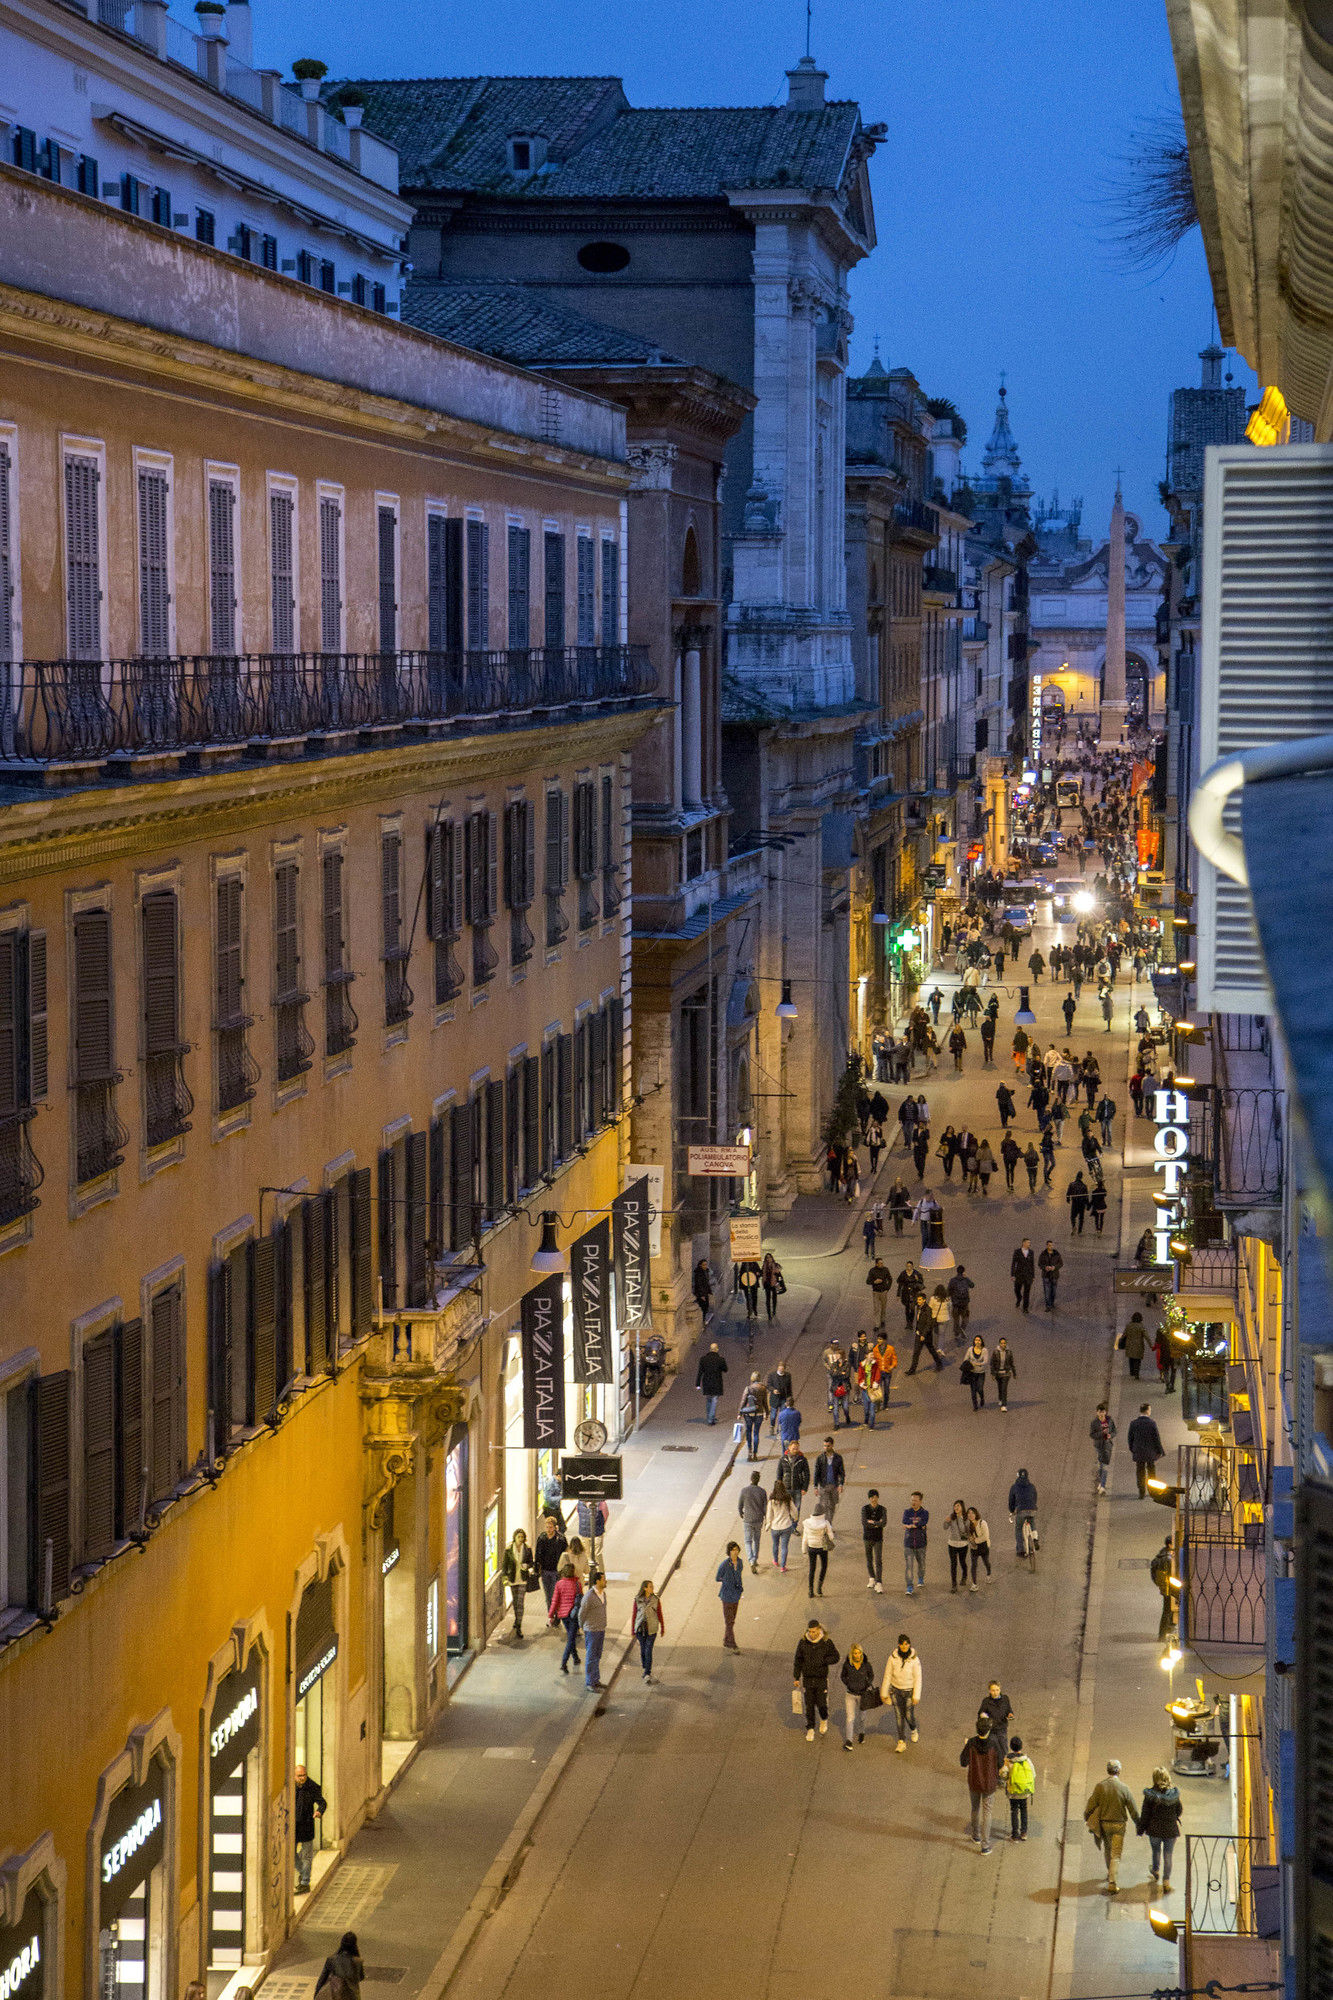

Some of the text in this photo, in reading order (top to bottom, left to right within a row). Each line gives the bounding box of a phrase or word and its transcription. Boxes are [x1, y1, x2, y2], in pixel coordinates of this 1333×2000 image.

[1153, 1090, 1190, 1265] HOTEL
[582, 1244, 602, 1376] PIAZZA ITALIA
[622, 1201, 642, 1323] PIAZZA ITALIA
[532, 1297, 555, 1441] PIAZZA ITALIA
[210, 1687, 258, 1757] SEPHORA
[102, 1798, 162, 1883] SEPHORA
